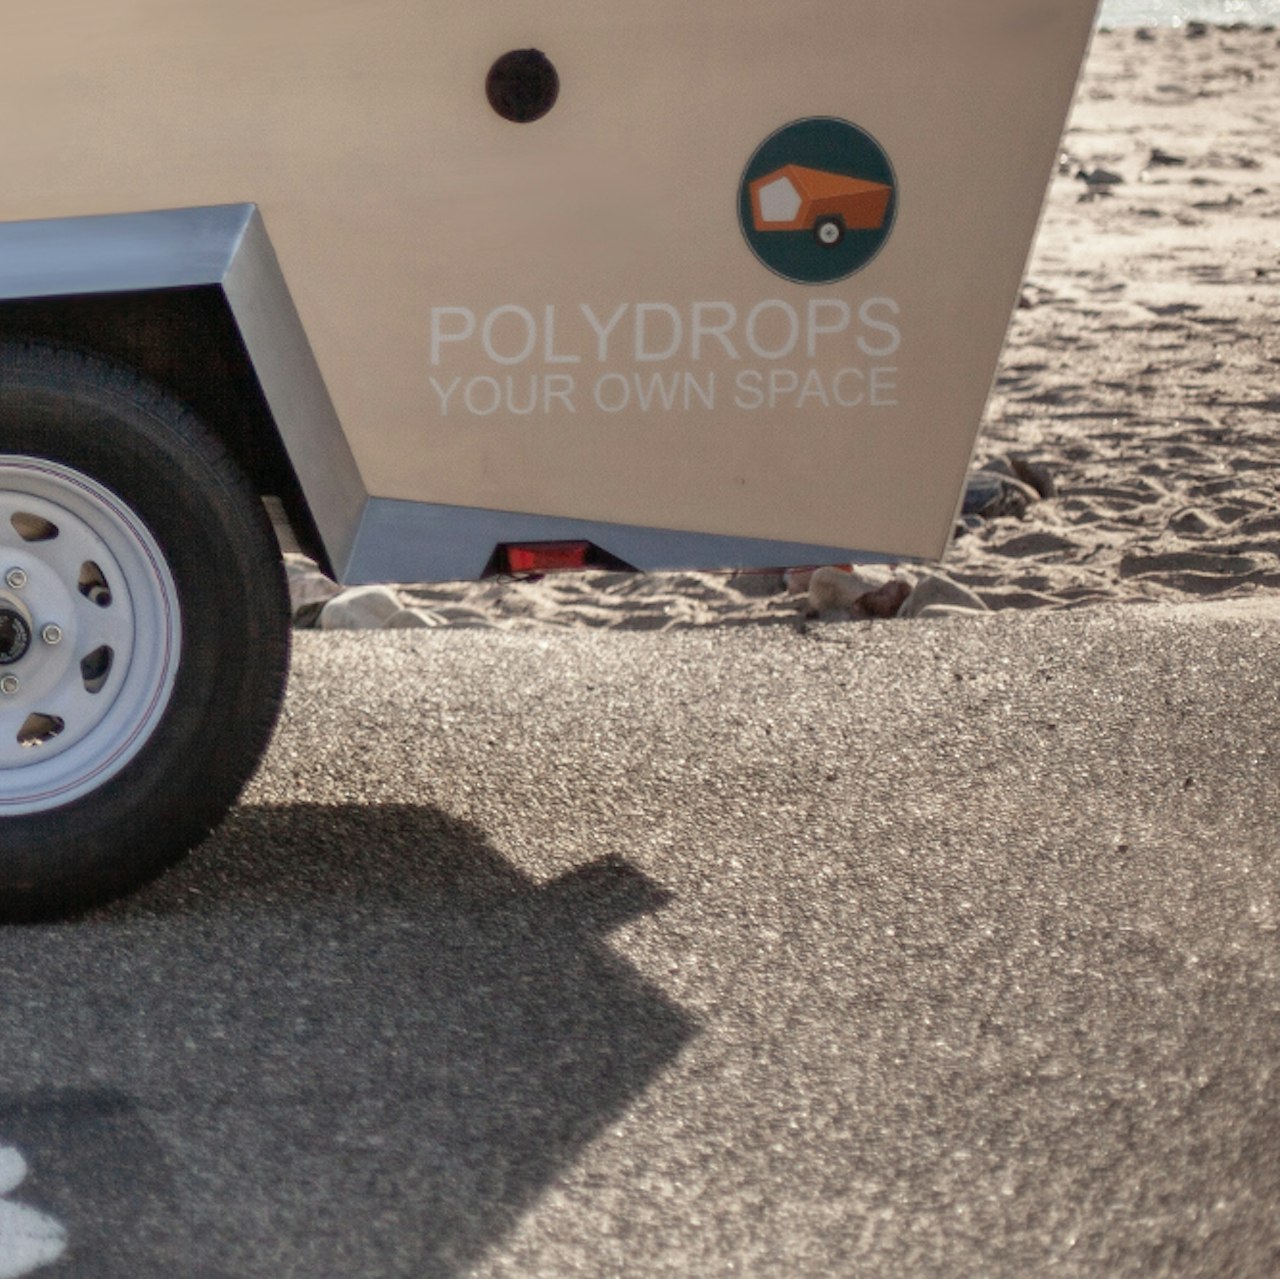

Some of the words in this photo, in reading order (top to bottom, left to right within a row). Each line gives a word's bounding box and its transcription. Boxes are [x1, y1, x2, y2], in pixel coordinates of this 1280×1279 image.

[430, 297, 902, 366] POLYDROPS
[429, 375, 576, 415] YOUR
[594, 372, 715, 412] OWN
[735, 368, 898, 409] SPACE
